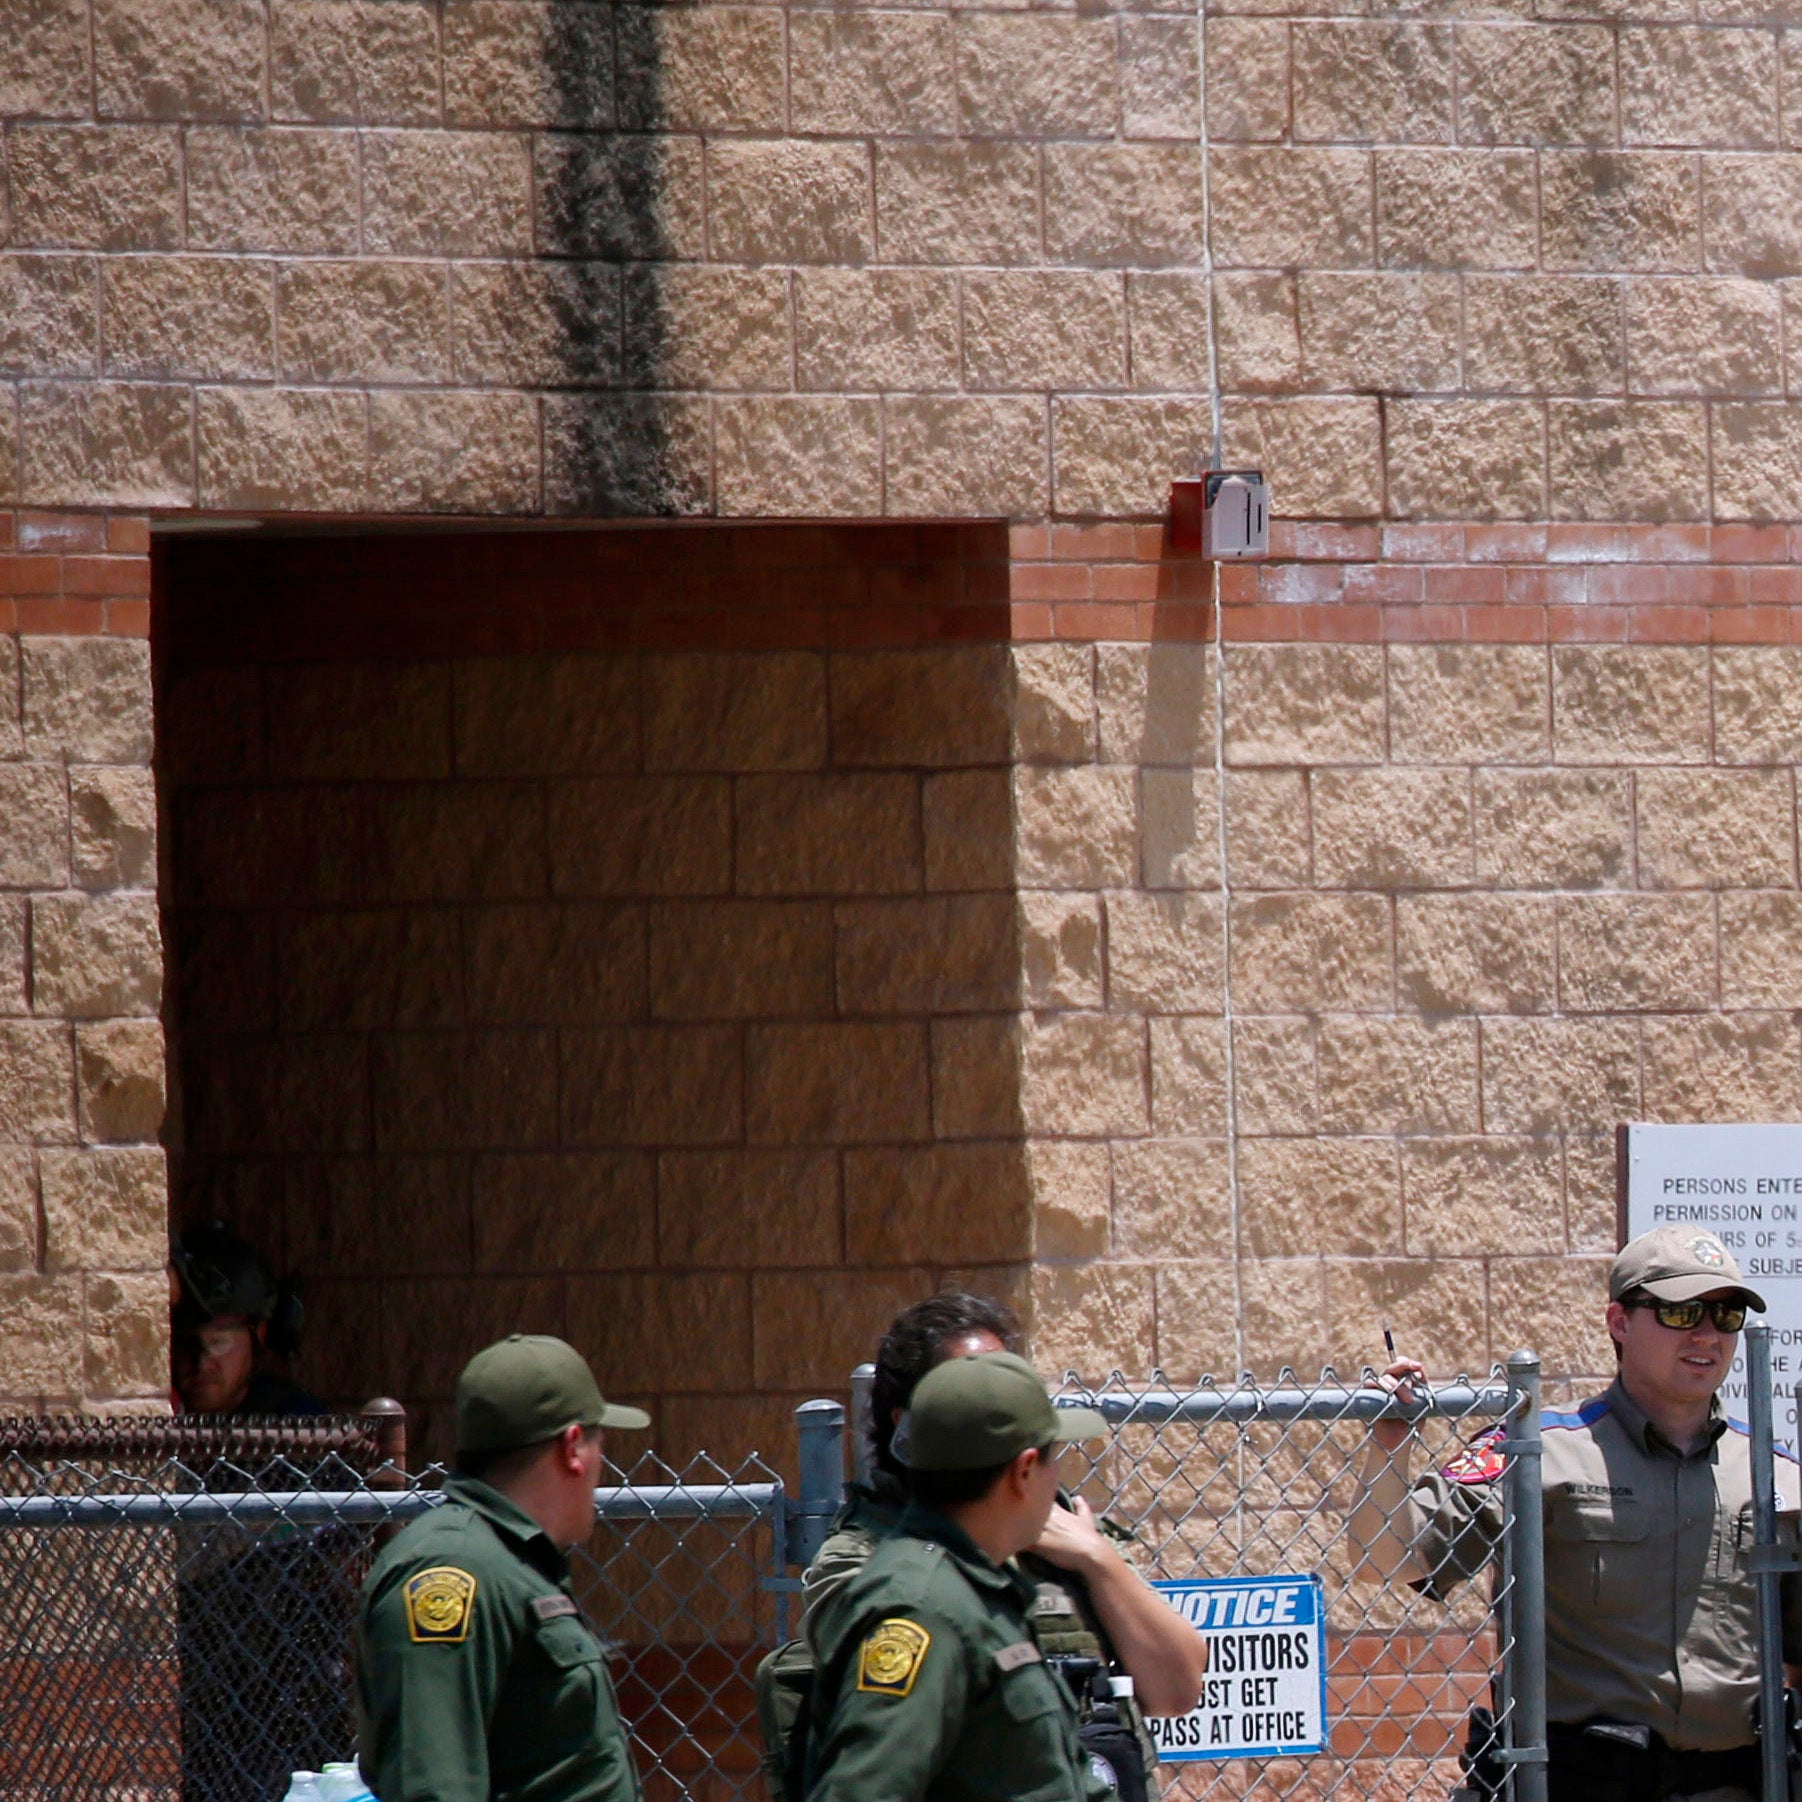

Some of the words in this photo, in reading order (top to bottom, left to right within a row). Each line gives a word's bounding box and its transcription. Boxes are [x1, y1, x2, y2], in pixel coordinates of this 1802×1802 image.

[1663, 1178, 1747, 1194] PERSONS
[1653, 1205, 1762, 1221] PERMISSION
[1771, 1205, 1797, 1221] ON
[1755, 1231, 1777, 1248] OF
[1160, 1588, 1300, 1627] NOTICE
[1241, 1677, 1279, 1708] GET
[1150, 1715, 1201, 1747] PASS
[1210, 1714, 1233, 1744] AT
[1242, 1711, 1307, 1743] OFFICE
